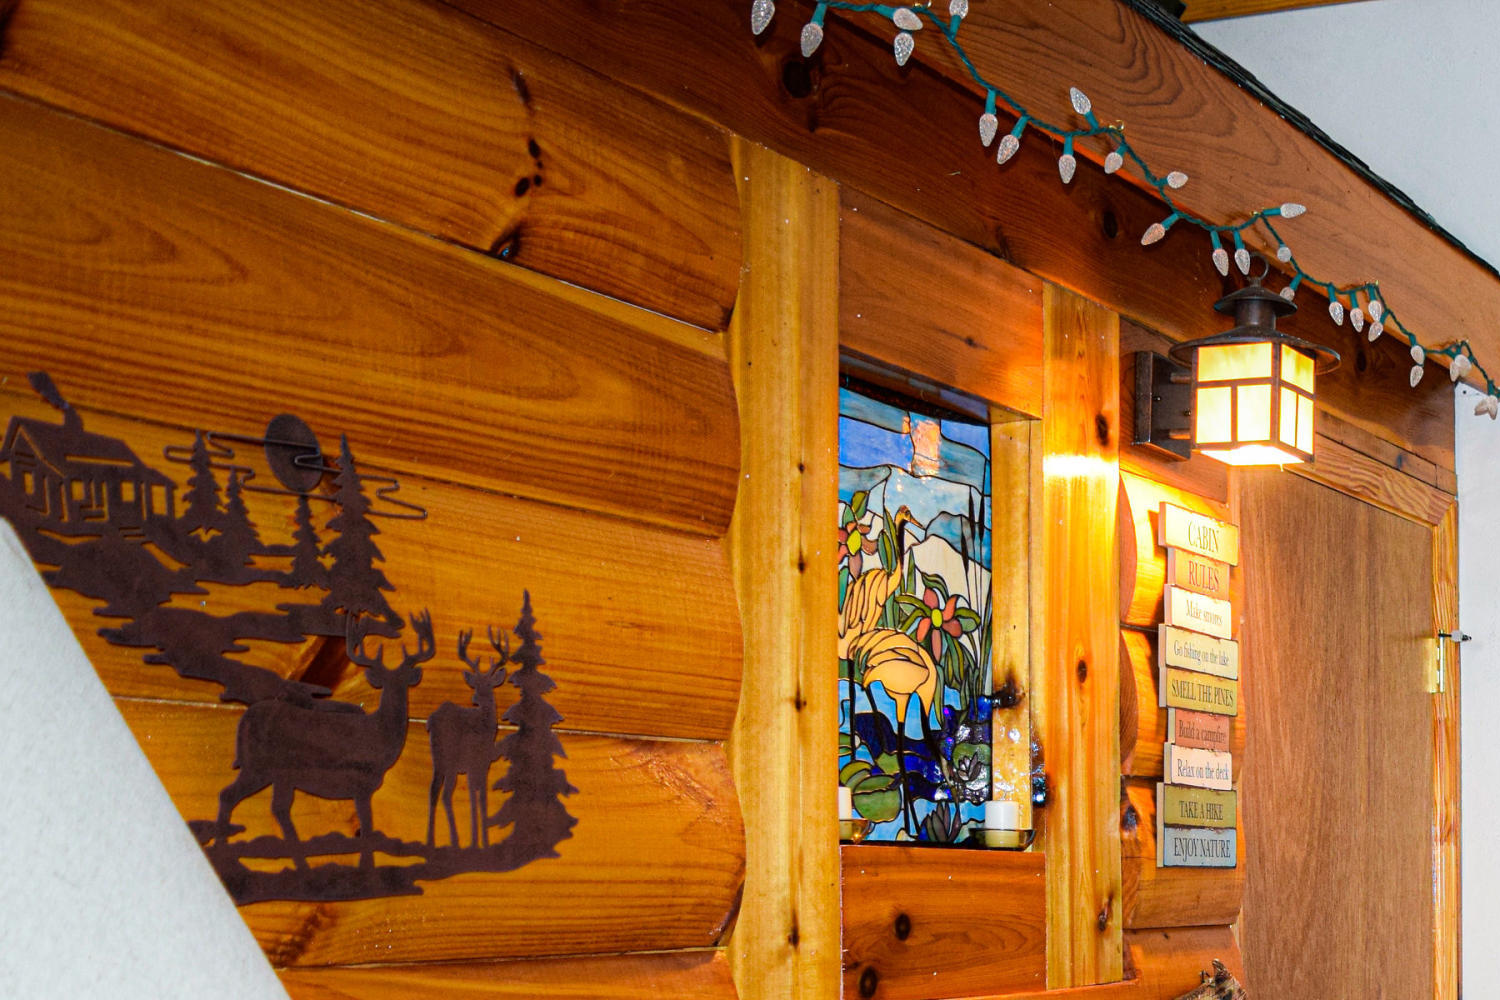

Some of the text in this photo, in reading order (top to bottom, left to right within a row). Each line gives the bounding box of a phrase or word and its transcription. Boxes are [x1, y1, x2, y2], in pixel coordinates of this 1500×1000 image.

[1187, 520, 1220, 553] CABIN
[1188, 560, 1220, 592] RULES
[1186, 599, 1203, 620] Make
[1174, 639, 1229, 666] Go fishing on the lake
[1172, 680, 1234, 708] SMELL THE PINES
[1179, 719, 1194, 740] Build
[1201, 725, 1227, 749] campfire
[1177, 758, 1229, 781] Relax on the deck
[1180, 800, 1223, 821] TAKE A HIKE
[1174, 837, 1231, 862] ENJOY NATURE
